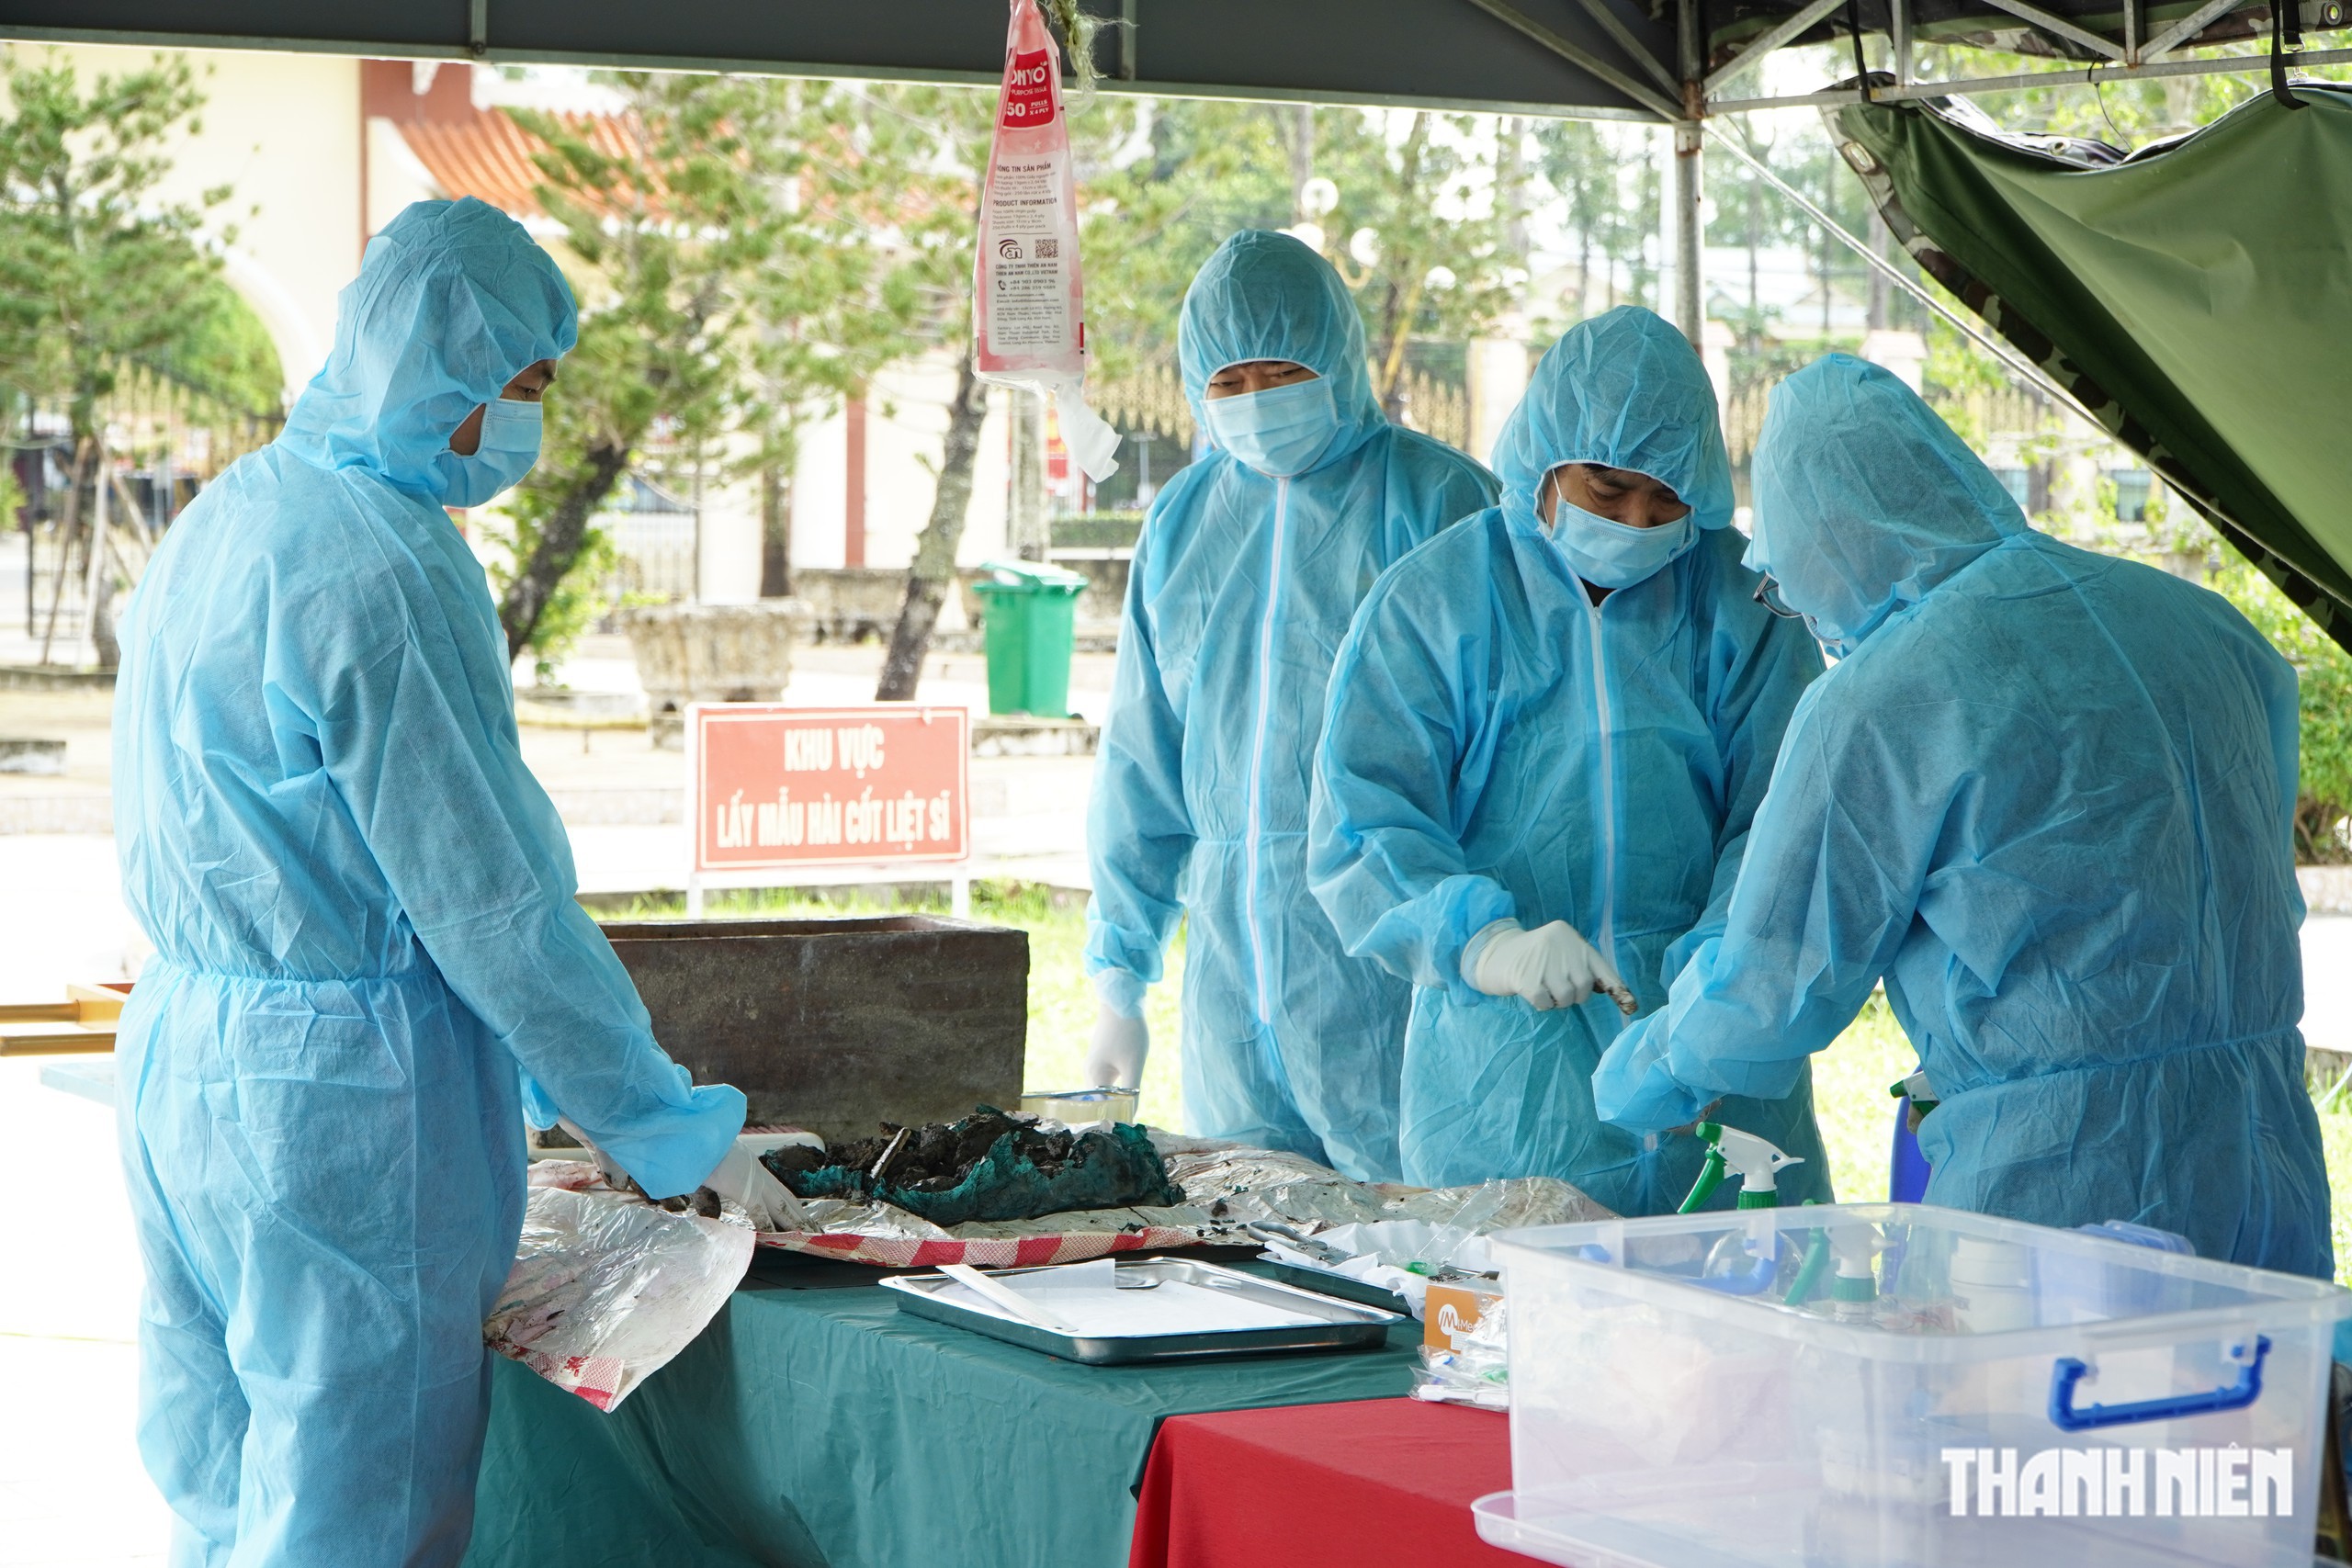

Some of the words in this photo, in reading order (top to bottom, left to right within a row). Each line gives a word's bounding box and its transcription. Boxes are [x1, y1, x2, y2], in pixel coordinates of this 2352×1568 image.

[1030, 99, 1048, 107] PULLS
[1020, 197, 1057, 206] INFORMATION
[785, 728, 832, 771] KHU
[838, 723, 885, 779] VỰC
[717, 788, 754, 848] LẤY
[758, 786, 804, 846] MẪU
[845, 785, 884, 844] CỐT
[886, 790, 926, 851] LIỆT
